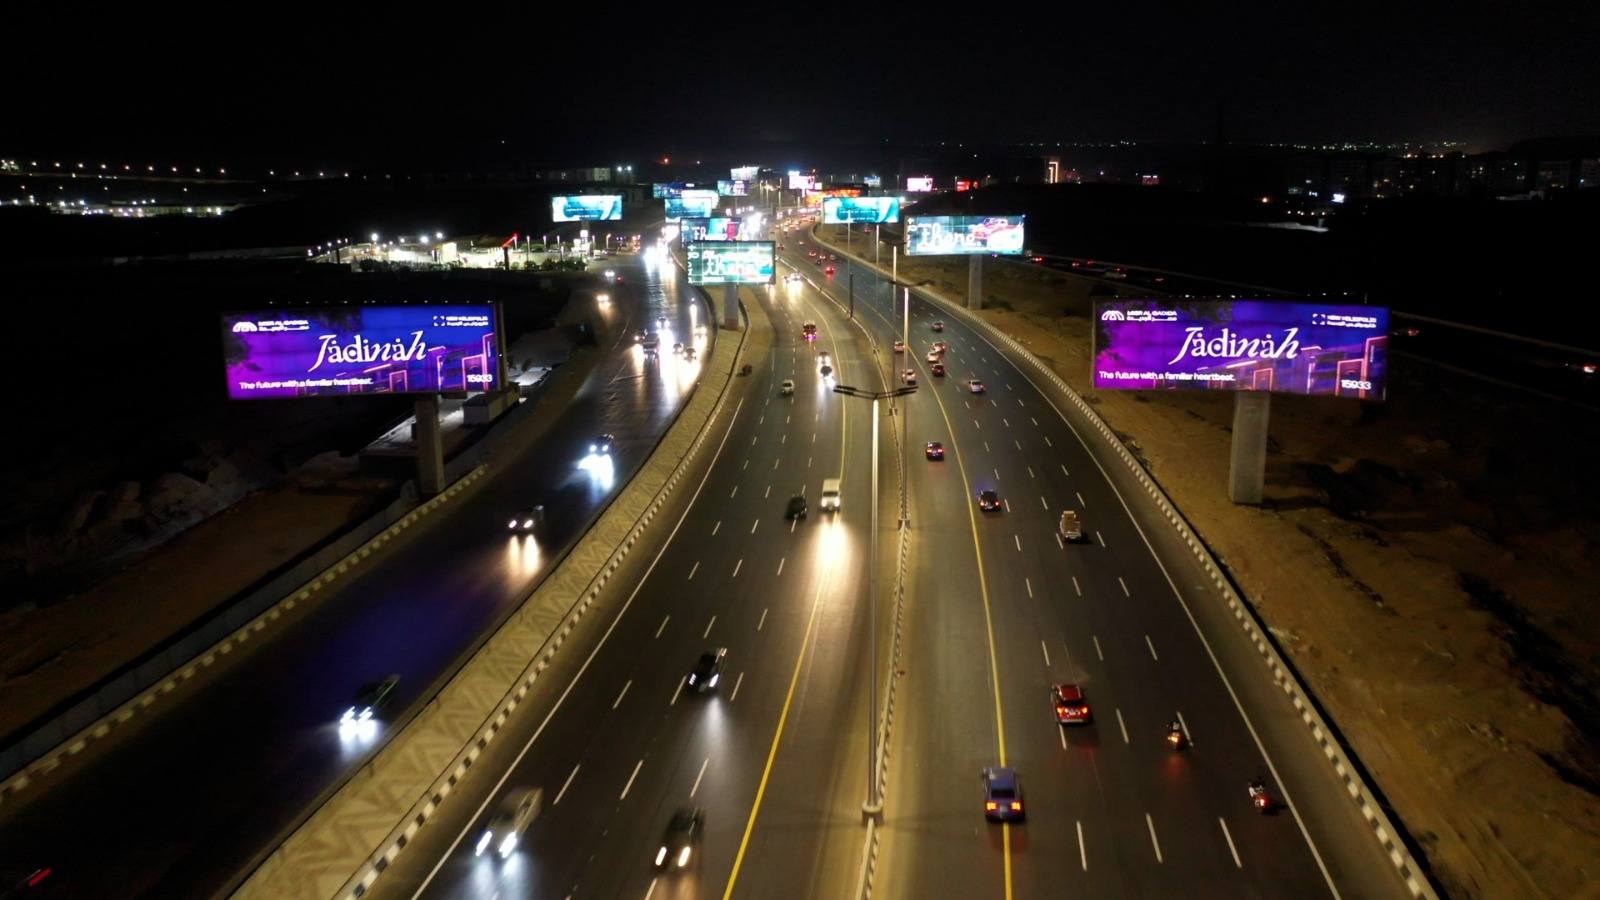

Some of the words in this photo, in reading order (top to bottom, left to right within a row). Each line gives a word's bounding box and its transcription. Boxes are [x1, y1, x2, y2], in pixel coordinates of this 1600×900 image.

[466, 374, 493, 383] 15933
[1099, 371, 1114, 379] The
[1115, 371, 1140, 379] future
[1140, 372, 1158, 380] with
[256, 381, 281, 389] future
[281, 380, 299, 388] with
[1341, 379, 1372, 390] 15933
